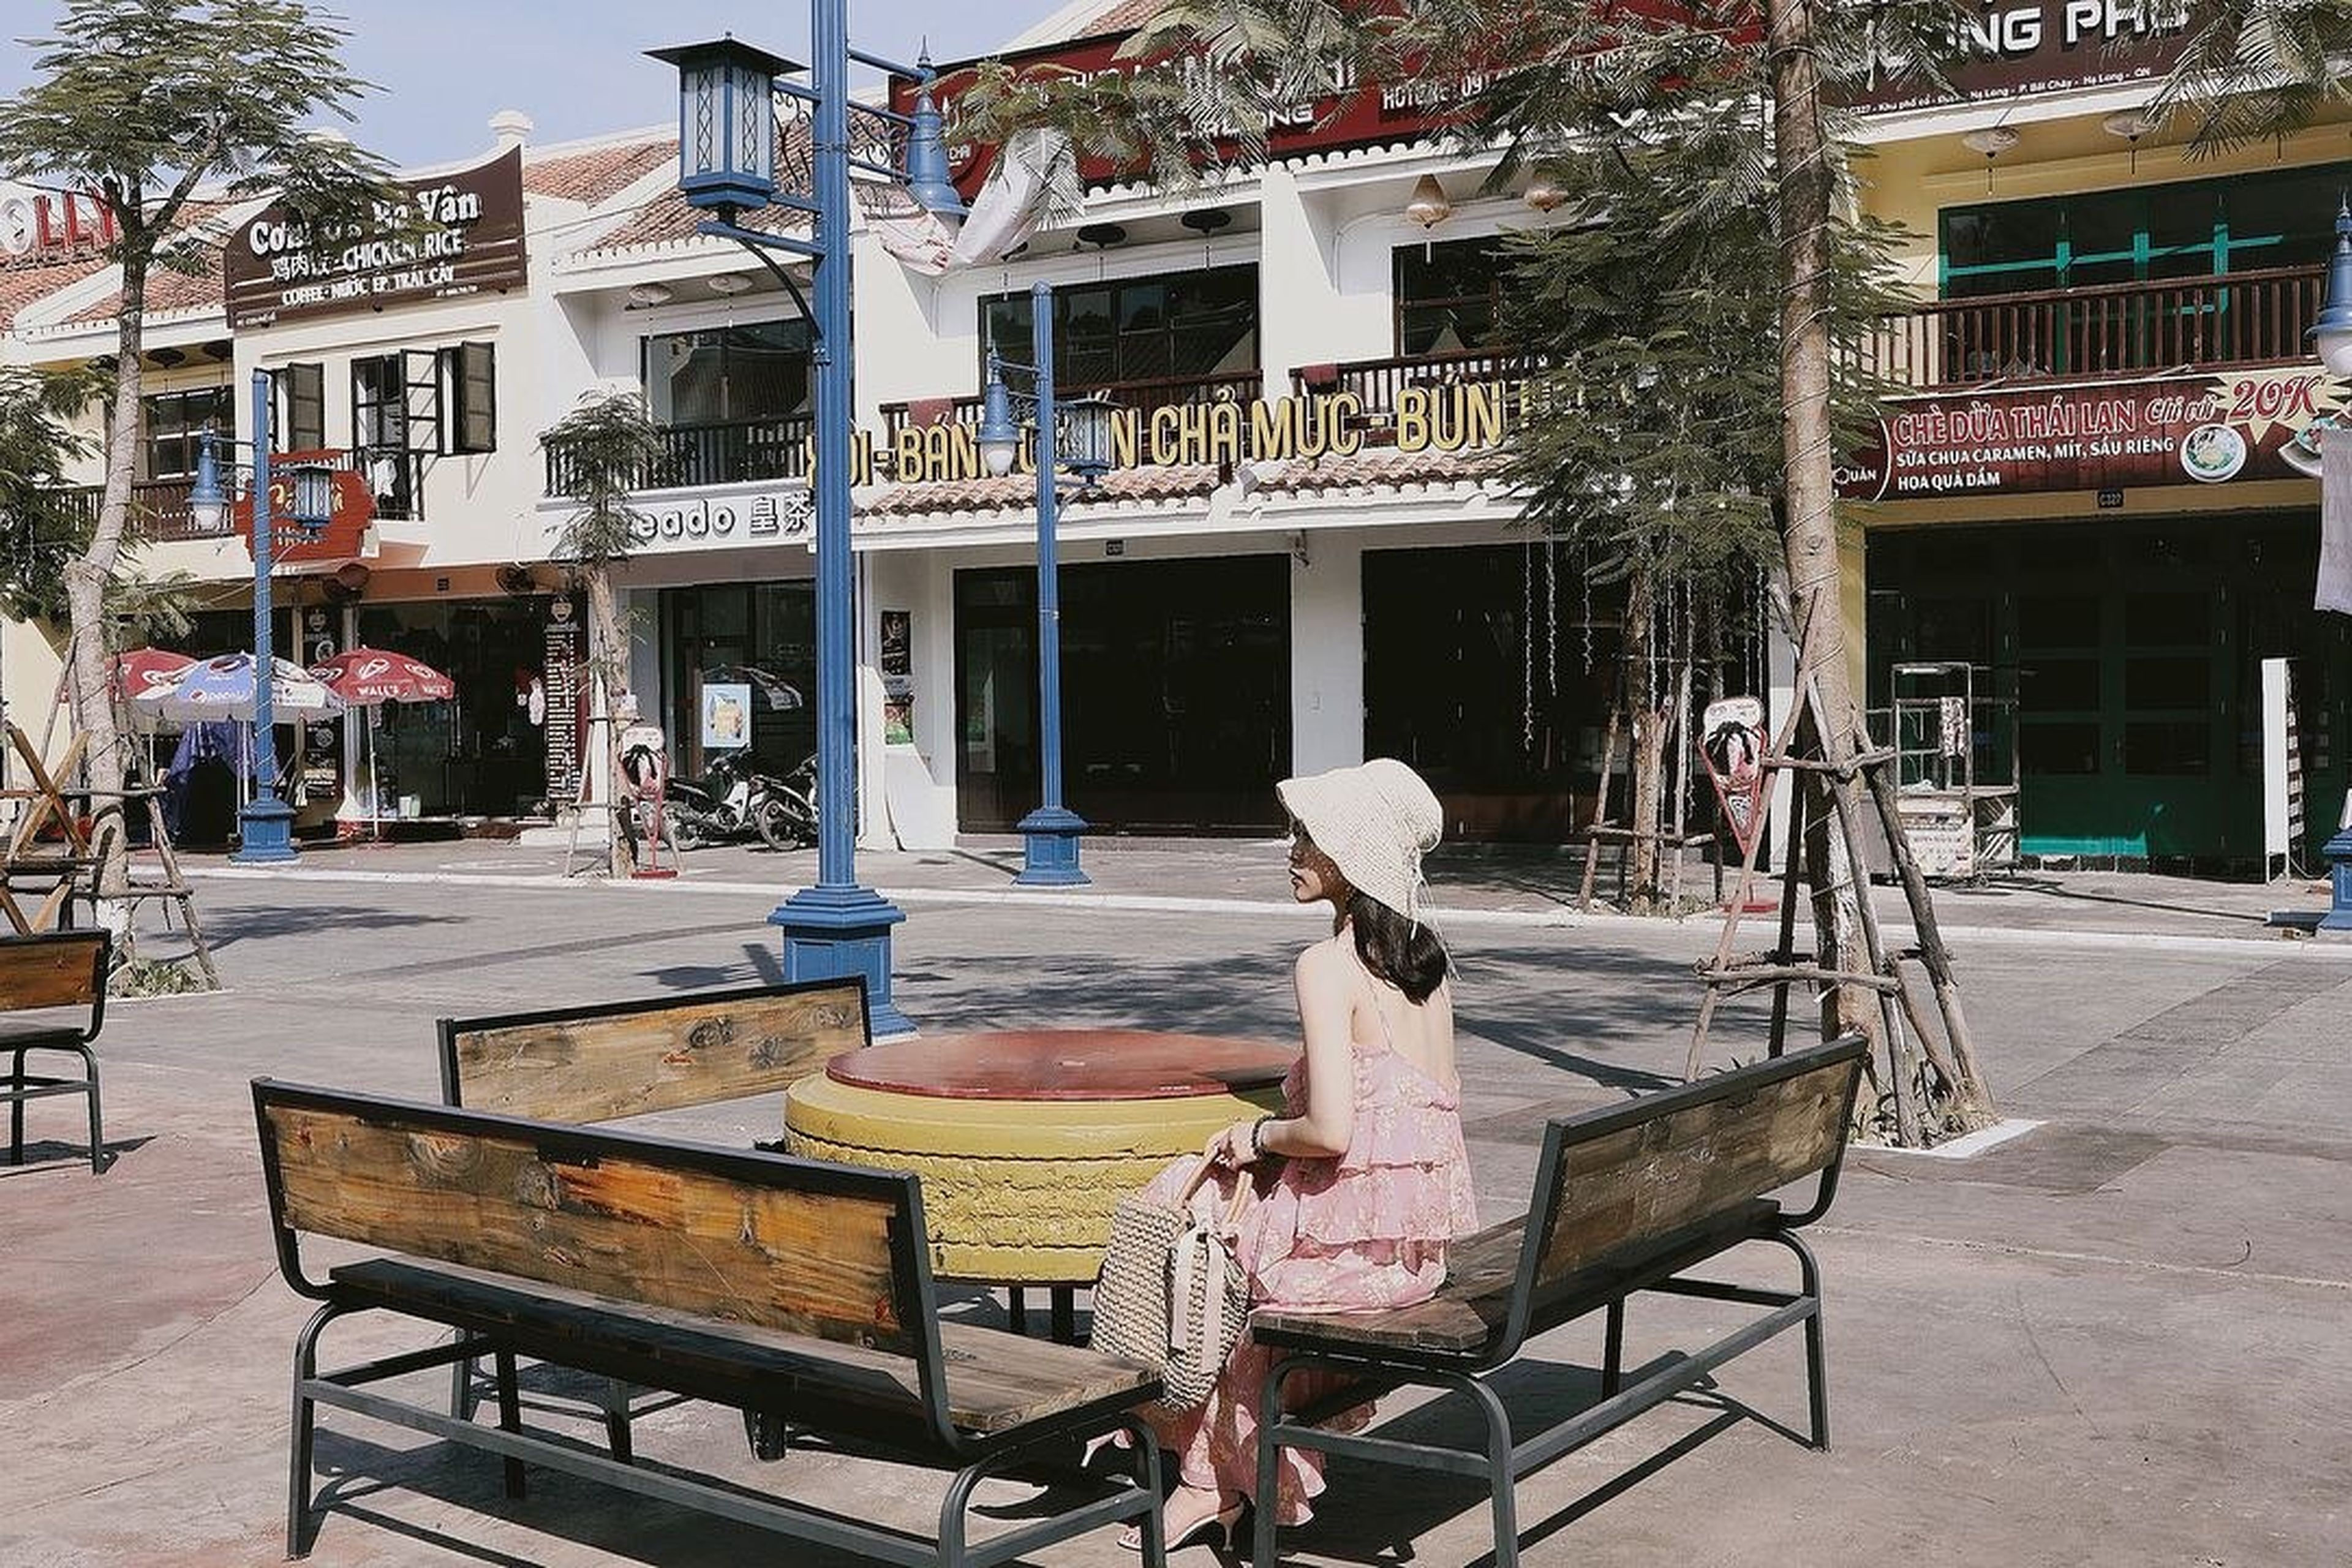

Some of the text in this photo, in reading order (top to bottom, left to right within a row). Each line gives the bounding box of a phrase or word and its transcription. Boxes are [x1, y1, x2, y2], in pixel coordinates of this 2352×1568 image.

[1985, 88, 2009, 99] Long
[2098, 72, 2124, 85] Long
[425, 228, 463, 259] RICE
[2227, 374, 2325, 422] 20K
[1151, 386, 1242, 466] CHẢ
[1251, 392, 1360, 470] MỰC
[1398, 372, 1501, 451] BÚN
[1893, 404, 1947, 447] CHÈ
[2011, 394, 2076, 439] THÁI
[2081, 400, 2136, 435] LAN
[1928, 450, 1970, 466] CHUA
[1972, 445, 2052, 462] CARAMEN,
[1898, 475, 1929, 491] HOA
